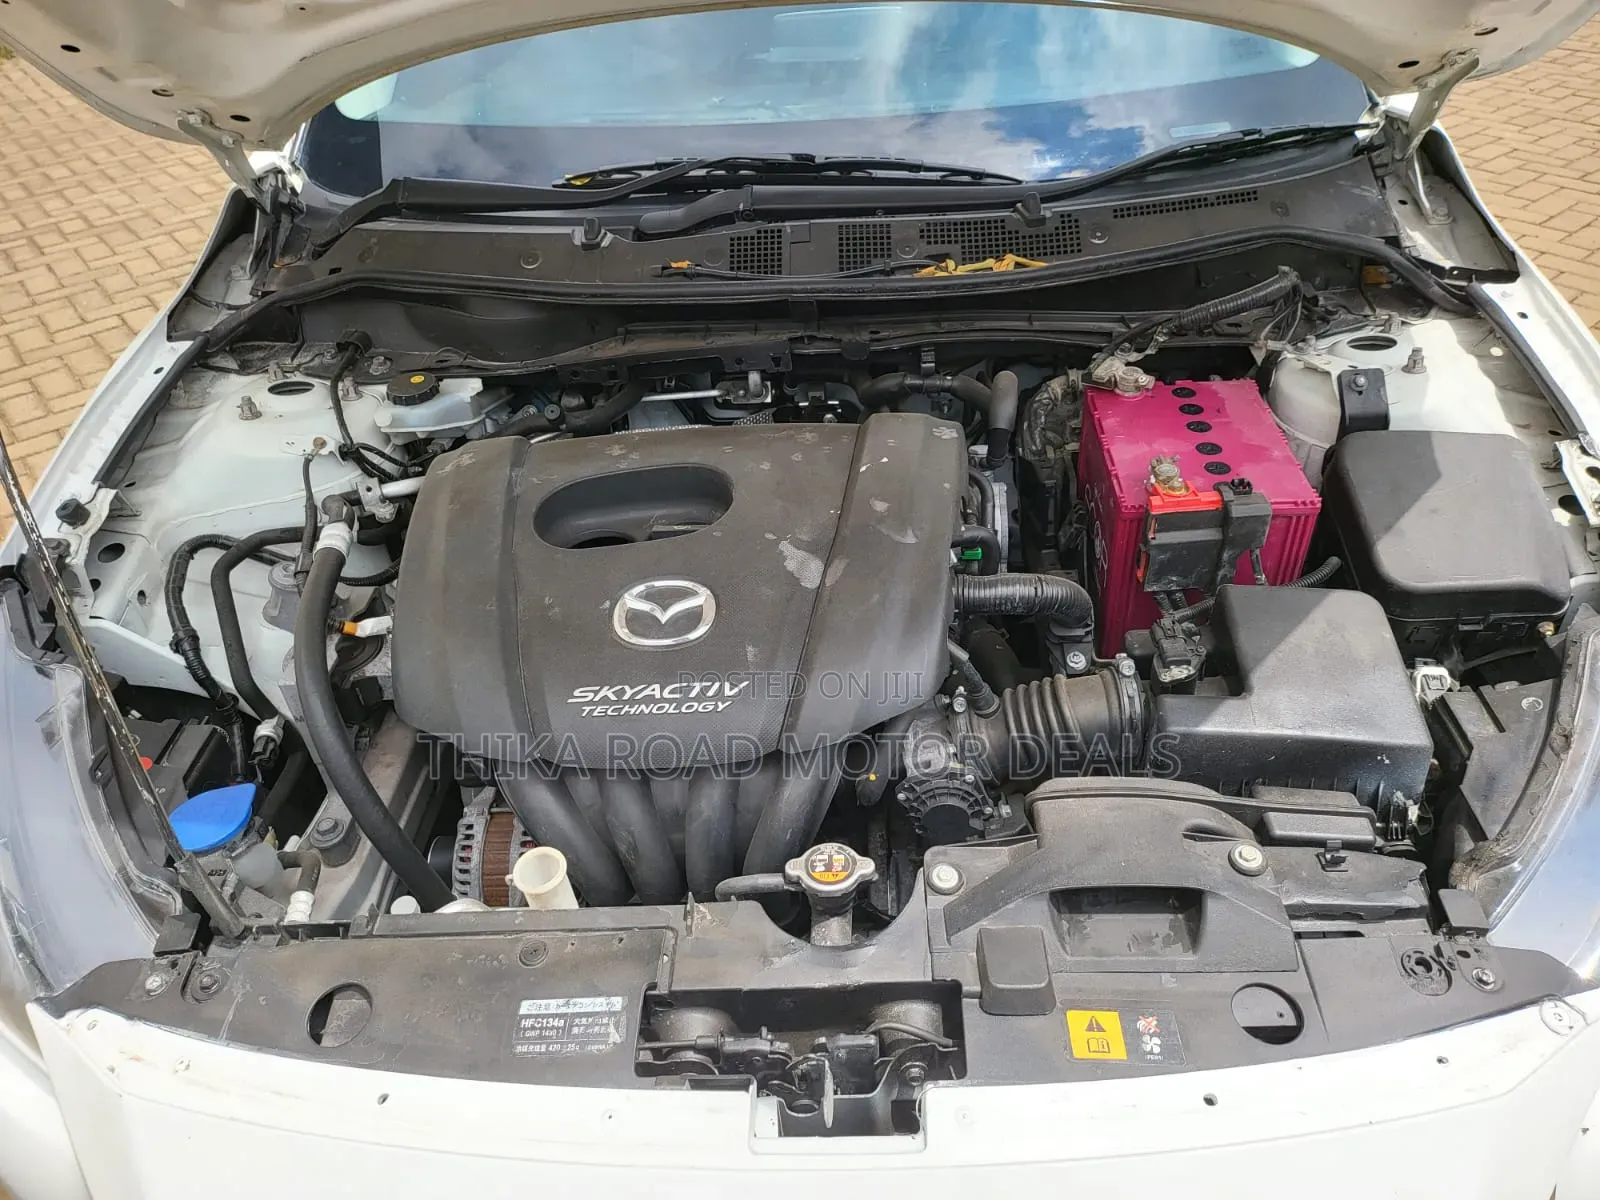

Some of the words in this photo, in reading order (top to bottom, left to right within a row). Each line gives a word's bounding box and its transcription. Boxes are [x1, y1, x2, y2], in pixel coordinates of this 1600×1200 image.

[567, 681, 749, 702] SKYACTIV
[581, 701, 733, 718] TECHNOLOGY
[520, 1018, 564, 1028] HFC134a
